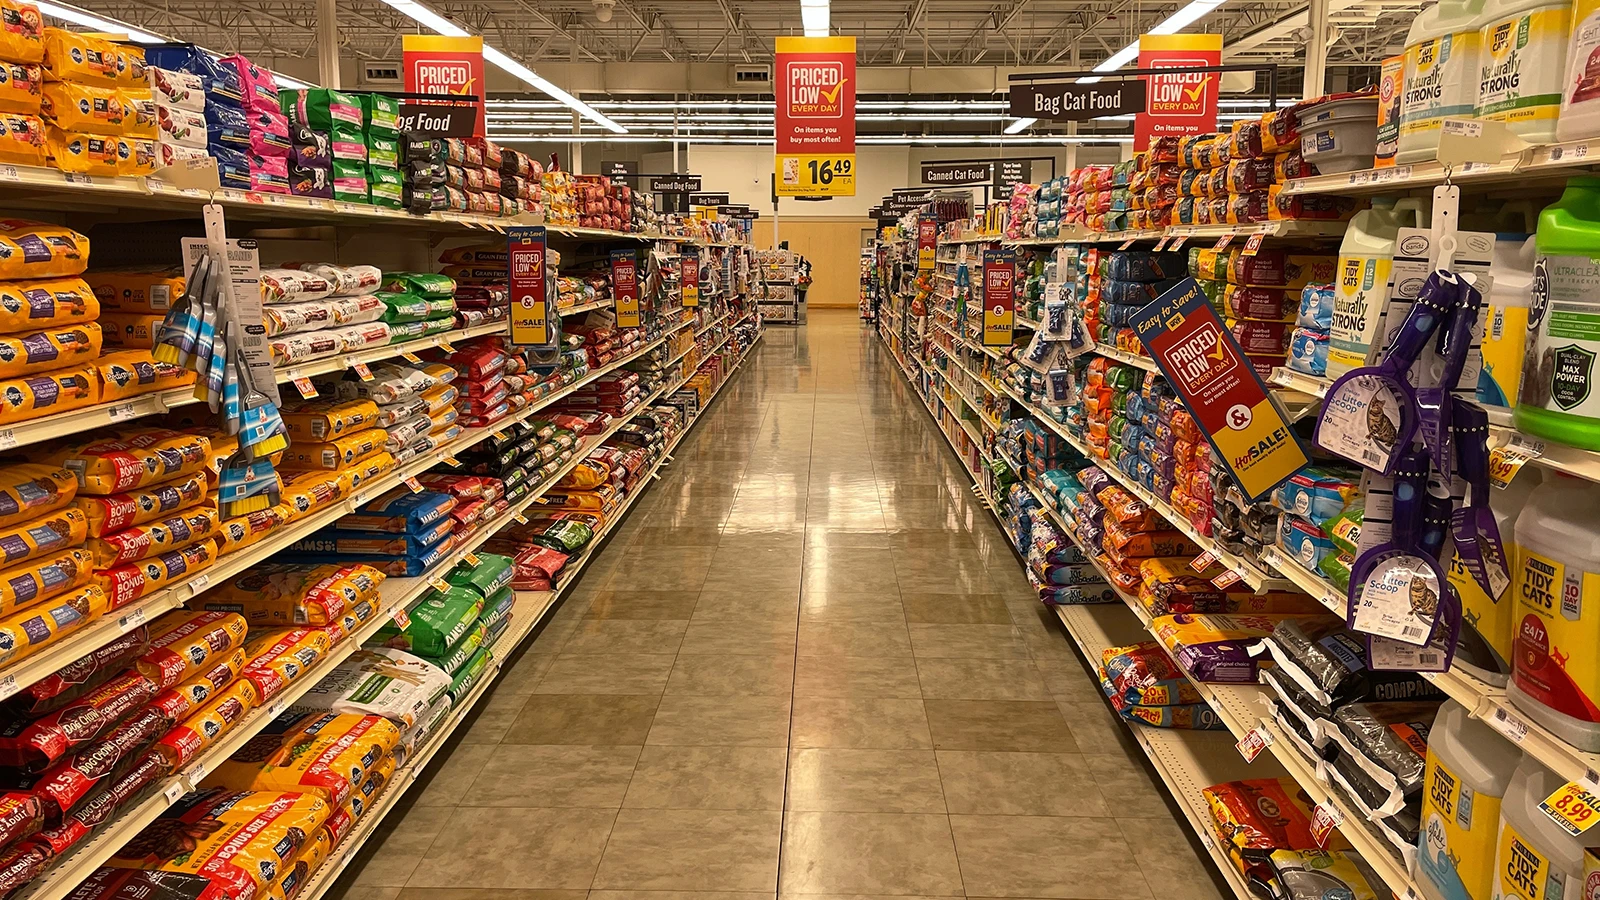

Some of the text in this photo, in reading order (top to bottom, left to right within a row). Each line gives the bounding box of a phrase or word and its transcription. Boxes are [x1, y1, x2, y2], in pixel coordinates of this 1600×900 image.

[1494, 30, 1509, 42] TIDY
[1520, 25, 1527, 33] 12
[1493, 41, 1509, 51] CATS
[1418, 55, 1433, 65] CATS
[420, 67, 466, 84] PRICED
[792, 68, 838, 85] PRICED
[1155, 66, 1202, 83] PRICED
[1154, 84, 1183, 102] LOW
[1480, 74, 1520, 95] STRONG
[421, 85, 448, 102] LOW
[792, 87, 820, 104] LOW
[1406, 85, 1441, 104] STRONG
[1035, 90, 1121, 115] Bag Cat Food
[398, 113, 451, 131] og Food
[927, 169, 985, 181] Canned Cat Food
[654, 181, 698, 191] Canned Dog Food
[515, 254, 539, 262] PRICED
[516, 264, 529, 272] LOW
[1345, 267, 1358, 276] TIDY
[1343, 278, 1357, 287] CATS
[1137, 315, 1162, 334] Easy
[1161, 307, 1171, 318] to
[1172, 286, 1199, 309] Save!
[1335, 291, 1368, 318] Naturally
[1332, 313, 1365, 332] STRONG
[1171, 329, 1217, 368] PRICED
[1561, 352, 1586, 360] DUAL-CLAY
[1181, 354, 1210, 383] LOW
[1190, 358, 1230, 389] EVERY DAY
[1562, 365, 1580, 374] MAX
[1211, 380, 1225, 393] items
[1225, 375, 1234, 384] you
[1556, 372, 1585, 384] POWER
[1204, 378, 1240, 405] buy most often!
[1557, 383, 1580, 392] 10-DAY
[1330, 396, 1357, 413] Scoop
[1342, 393, 1367, 408] Litter
[1231, 409, 1249, 426] &
[120, 463, 144, 478] BONUS
[111, 502, 136, 518] BONUS
[107, 516, 124, 528] SIZE
[122, 533, 151, 550] BONUS
[1070, 568, 1081, 578] Kit
[1530, 558, 1555, 576] PURINA
[117, 575, 145, 593] BONUS
[1370, 580, 1398, 594] Scoop
[1525, 568, 1553, 592] TIDY
[116, 590, 133, 604] SIZE
[1070, 588, 1081, 597] Kit
[1522, 584, 1554, 609] CATS
[1565, 584, 1579, 598] 10
[1564, 596, 1578, 604] DAY
[1564, 602, 1577, 610] ODOR
[1524, 622, 1544, 641] 24/7
[164, 660, 186, 679] BONUS
[444, 651, 465, 674] IAMS
[453, 675, 472, 697] IAMS
[1144, 688, 1157, 697] 20
[1143, 695, 1167, 704] BAG!
[63, 710, 99, 735] DOG CHOW
[181, 737, 202, 757] BONUS
[79, 741, 115, 775] DOG CHOW
[1433, 772, 1453, 797] TIDY
[76, 792, 111, 821] DOG CHOW
[1431, 785, 1453, 815] CATS
[1556, 795, 1592, 822] 8.99
[5, 810, 28, 831] ADULT
[1552, 811, 1563, 821] SAVE
[218, 818, 267, 860] BONUS SIZE
[1516, 840, 1540, 868] PURINA
[1511, 847, 1538, 880] TIDY
[1507, 862, 1538, 898] CATS
